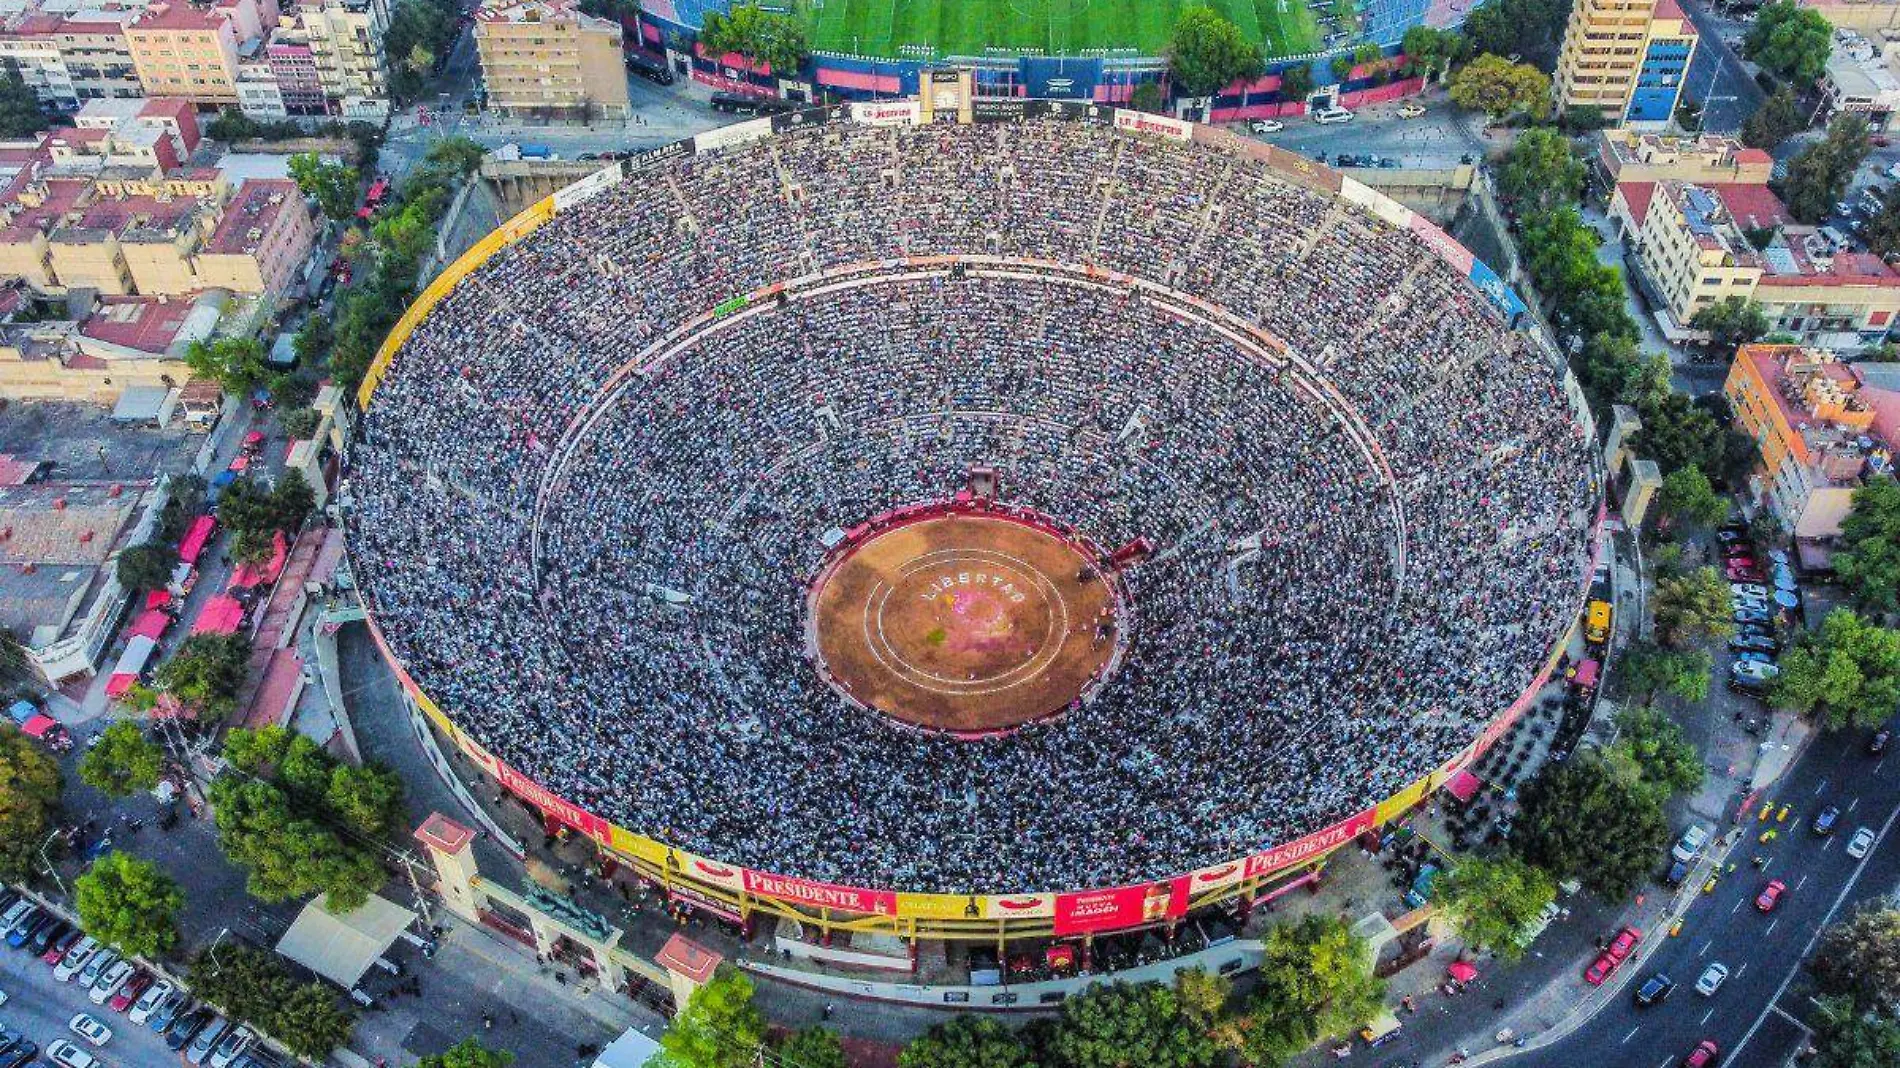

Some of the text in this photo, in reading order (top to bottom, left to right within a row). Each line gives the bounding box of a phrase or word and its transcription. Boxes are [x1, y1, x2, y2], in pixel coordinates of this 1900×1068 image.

[920, 572, 1025, 602] LIBERTAD
[1250, 826, 1347, 870] PRESIDENTE
[750, 872, 861, 907] PRESIDENTE
